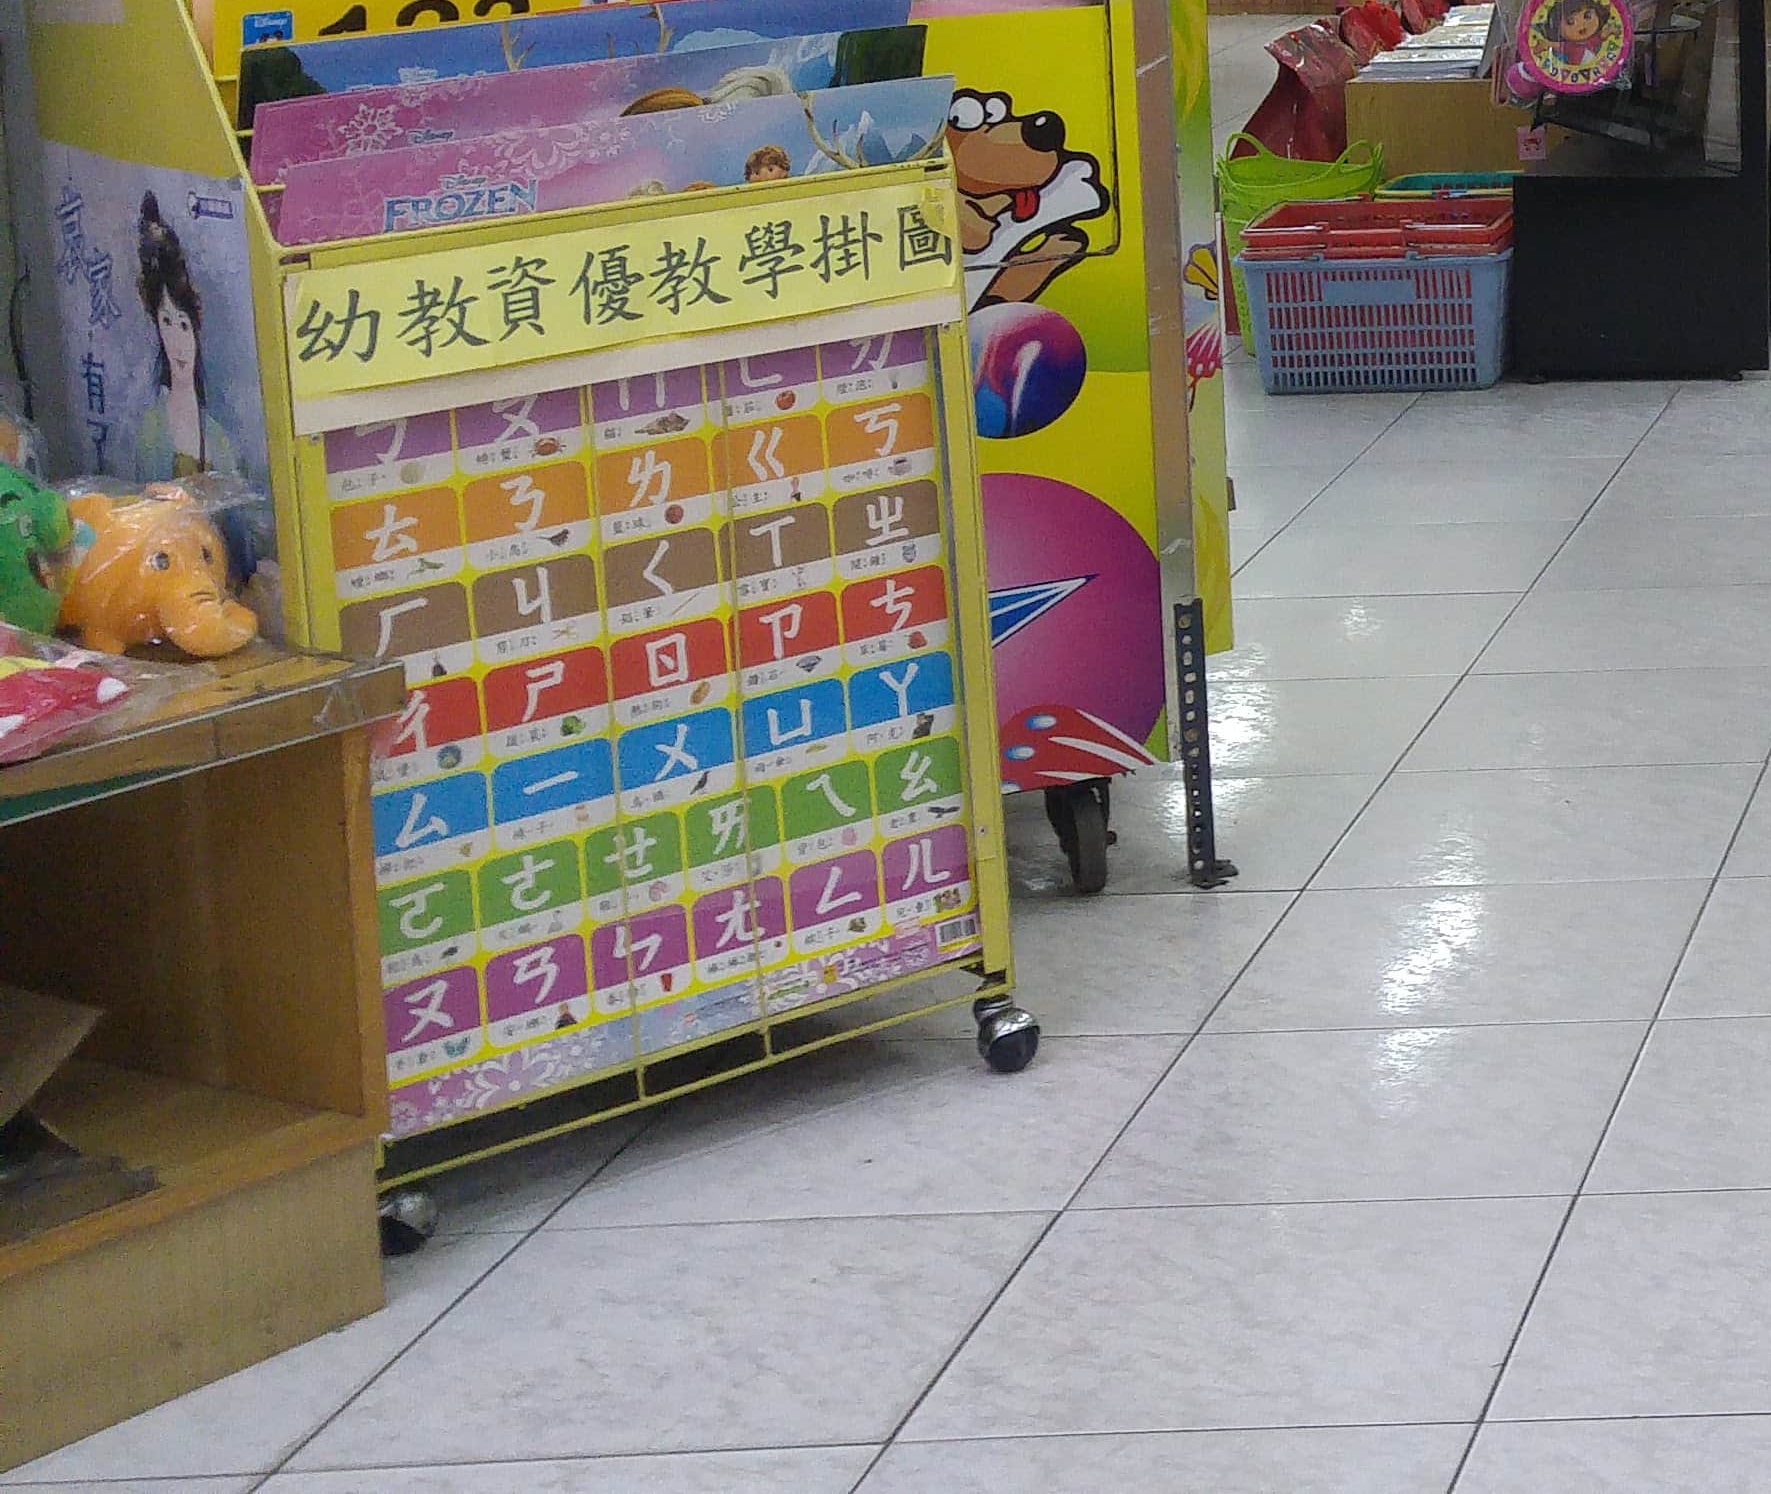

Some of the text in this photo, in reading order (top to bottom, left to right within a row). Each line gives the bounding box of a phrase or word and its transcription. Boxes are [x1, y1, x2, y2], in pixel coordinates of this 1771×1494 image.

[294, 203, 954, 366] 幼教資優教學掛圖
[384, 180, 538, 234] FROZEN
[364, 402, 903, 561] ㄊ ㄋ ㄌ ㄍ ㄎ
[511, 566, 553, 626] ㄐ
[865, 494, 912, 546] ㄓ
[522, 658, 566, 723] ㄕ
[758, 602, 804, 662] ㄗ
[869, 578, 918, 636] ㄘ
[396, 792, 450, 849] ㄙ
[766, 698, 814, 747] ㄩ
[877, 662, 920, 716] ㄚ
[500, 854, 558, 911] ㄜ
[897, 750, 941, 804] ㄠ
[512, 946, 562, 1006] ㄢ
[904, 836, 953, 889] ㄦ
